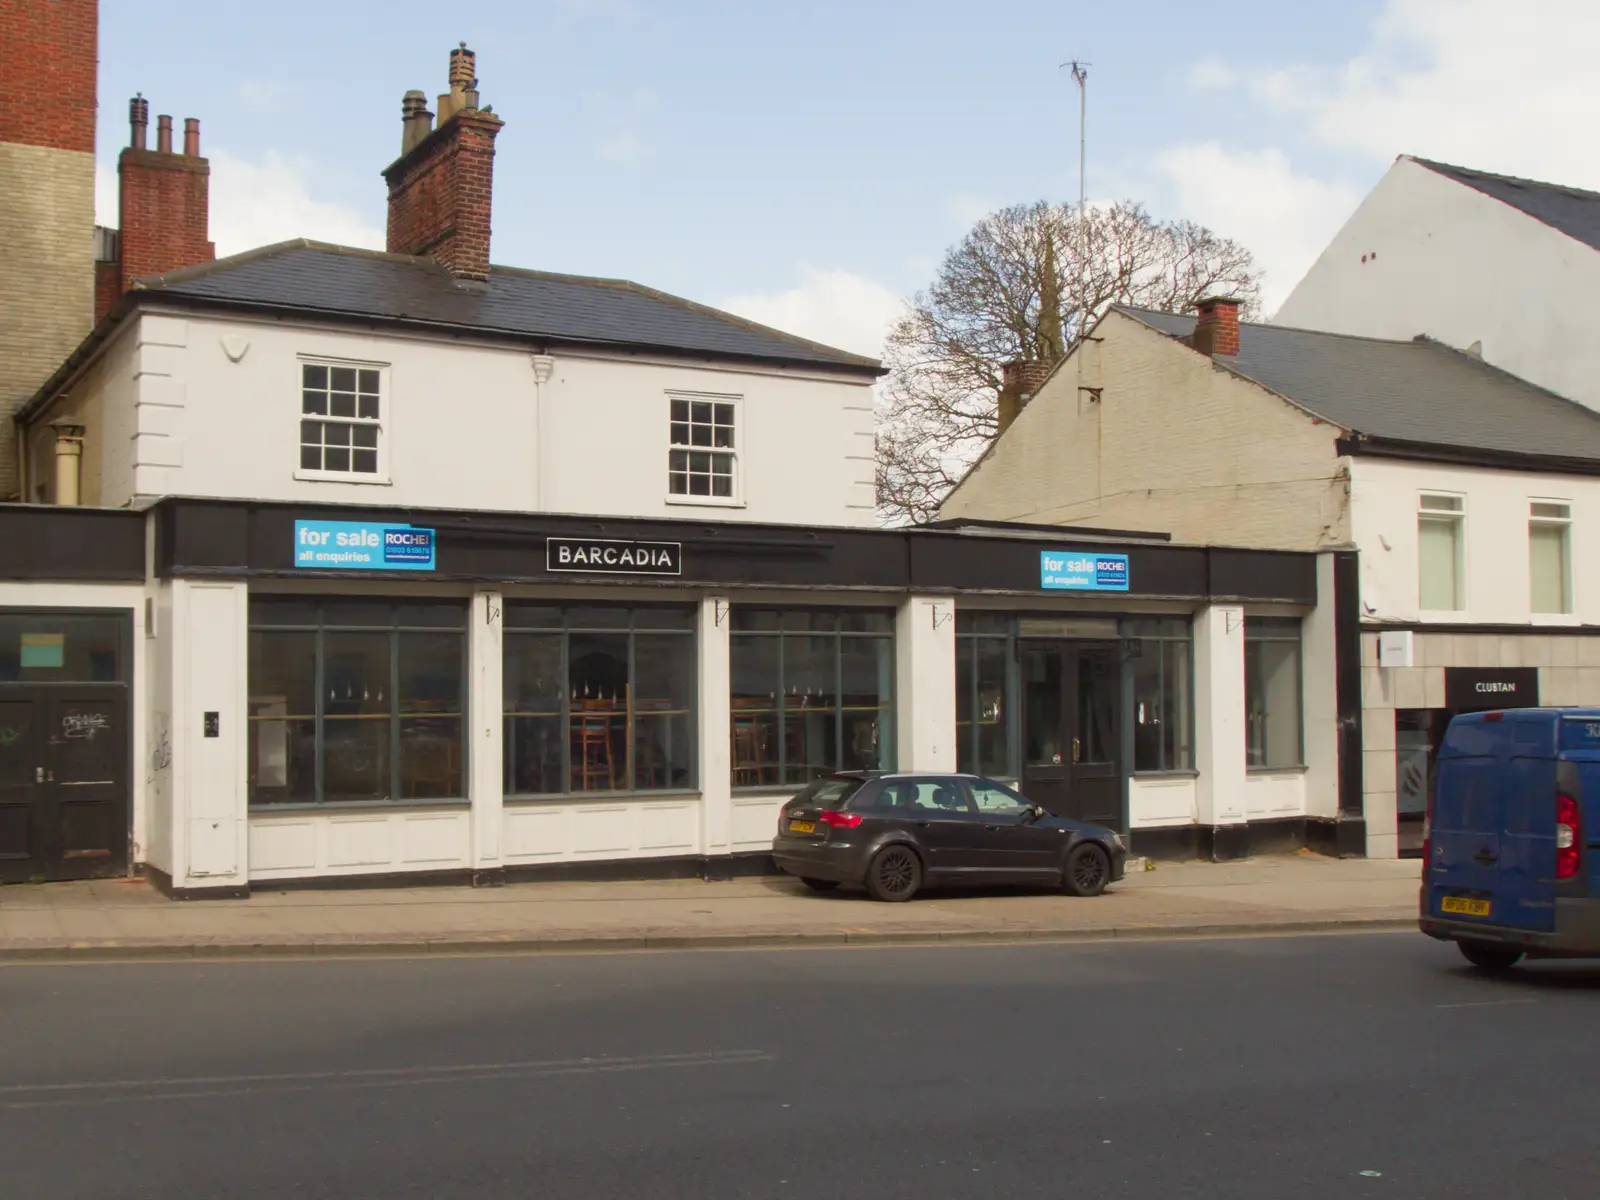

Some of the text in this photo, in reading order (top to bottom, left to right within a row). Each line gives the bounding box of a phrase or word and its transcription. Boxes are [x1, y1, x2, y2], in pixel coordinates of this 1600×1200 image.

[299, 527, 380, 547] for sale
[299, 551, 371, 564] all enquiries
[558, 546, 672, 567] BARCADIA
[1044, 557, 1095, 573] for sale
[1475, 682, 1516, 693] CLUBTAN
